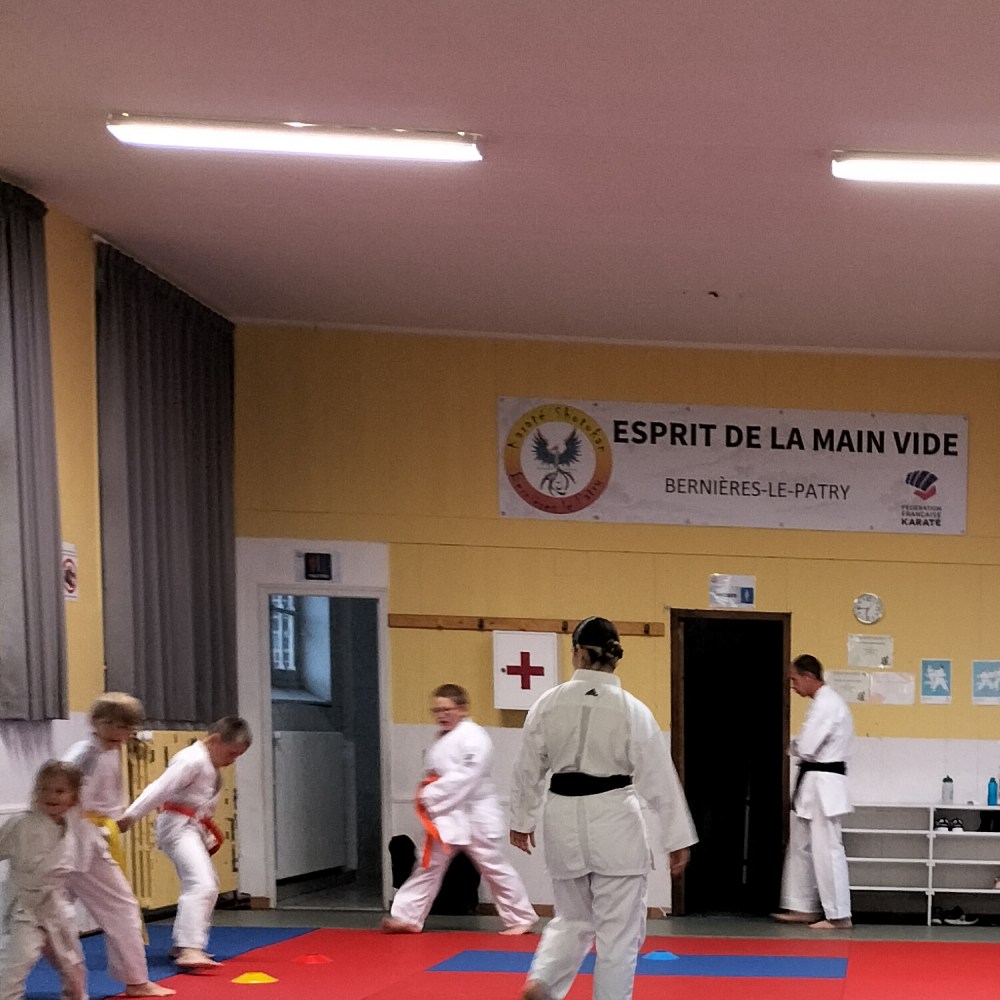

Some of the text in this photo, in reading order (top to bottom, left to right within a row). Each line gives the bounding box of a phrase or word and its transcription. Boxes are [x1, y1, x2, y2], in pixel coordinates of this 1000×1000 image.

[612, 419, 959, 456] ESPRIT DE LA MAIN VIDE
[665, 476, 850, 500] BERNIÈRES-LE-PATRY
